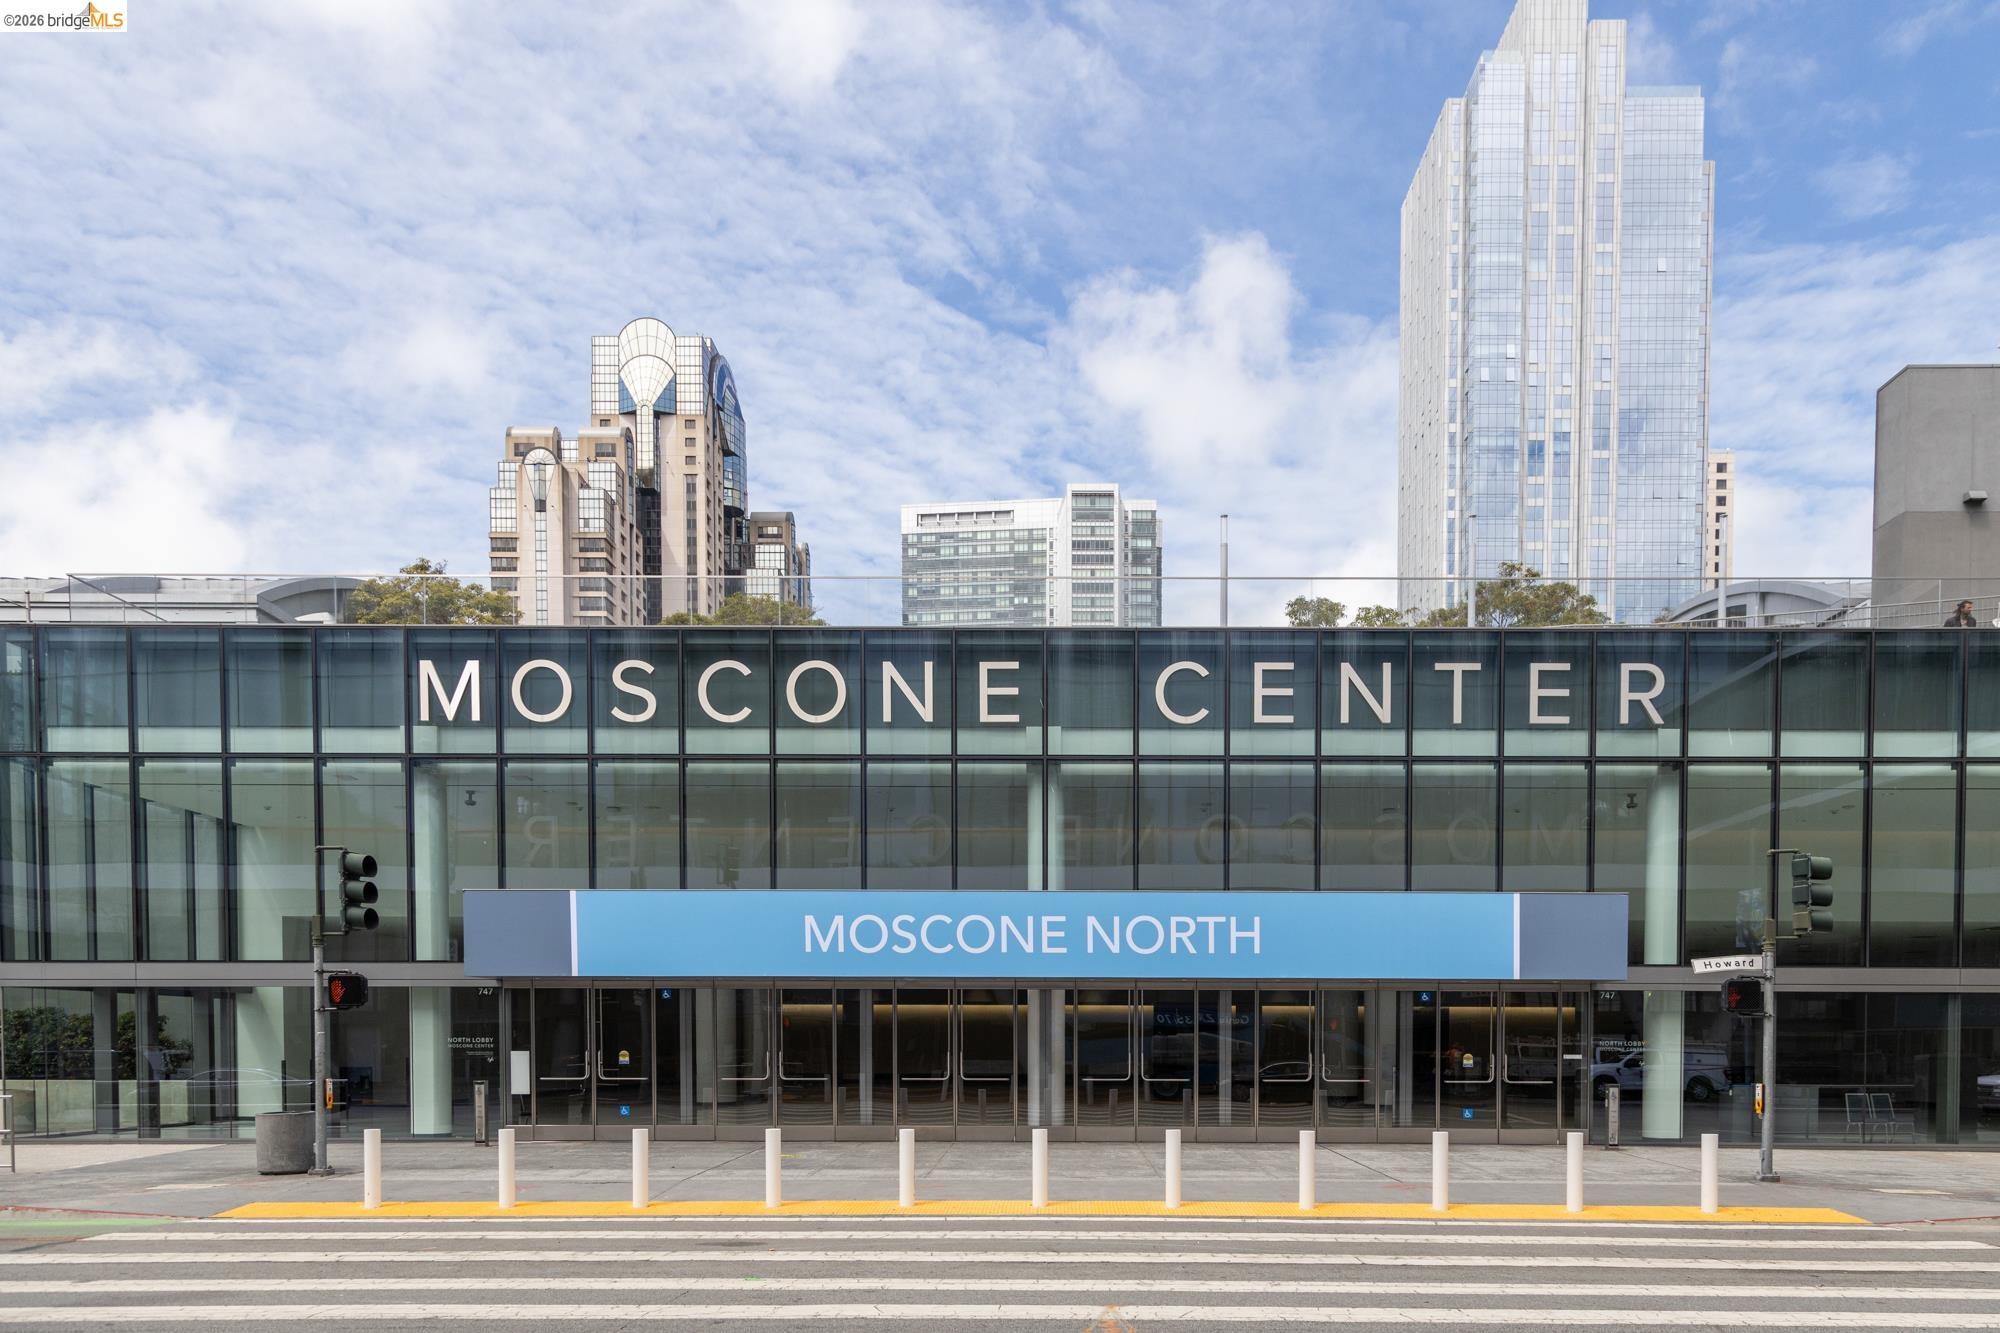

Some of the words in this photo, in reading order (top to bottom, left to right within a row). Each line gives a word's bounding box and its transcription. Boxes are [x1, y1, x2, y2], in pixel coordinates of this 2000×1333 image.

[418, 658, 1021, 724] MOSCONE
[1154, 660, 1667, 726] CENTER
[803, 913, 1068, 955] MOSCONE
[1086, 914, 1262, 955] NORTH
[1703, 958, 1755, 970] Howard
[478, 987, 494, 996] 747
[1600, 991, 1615, 1000] 747
